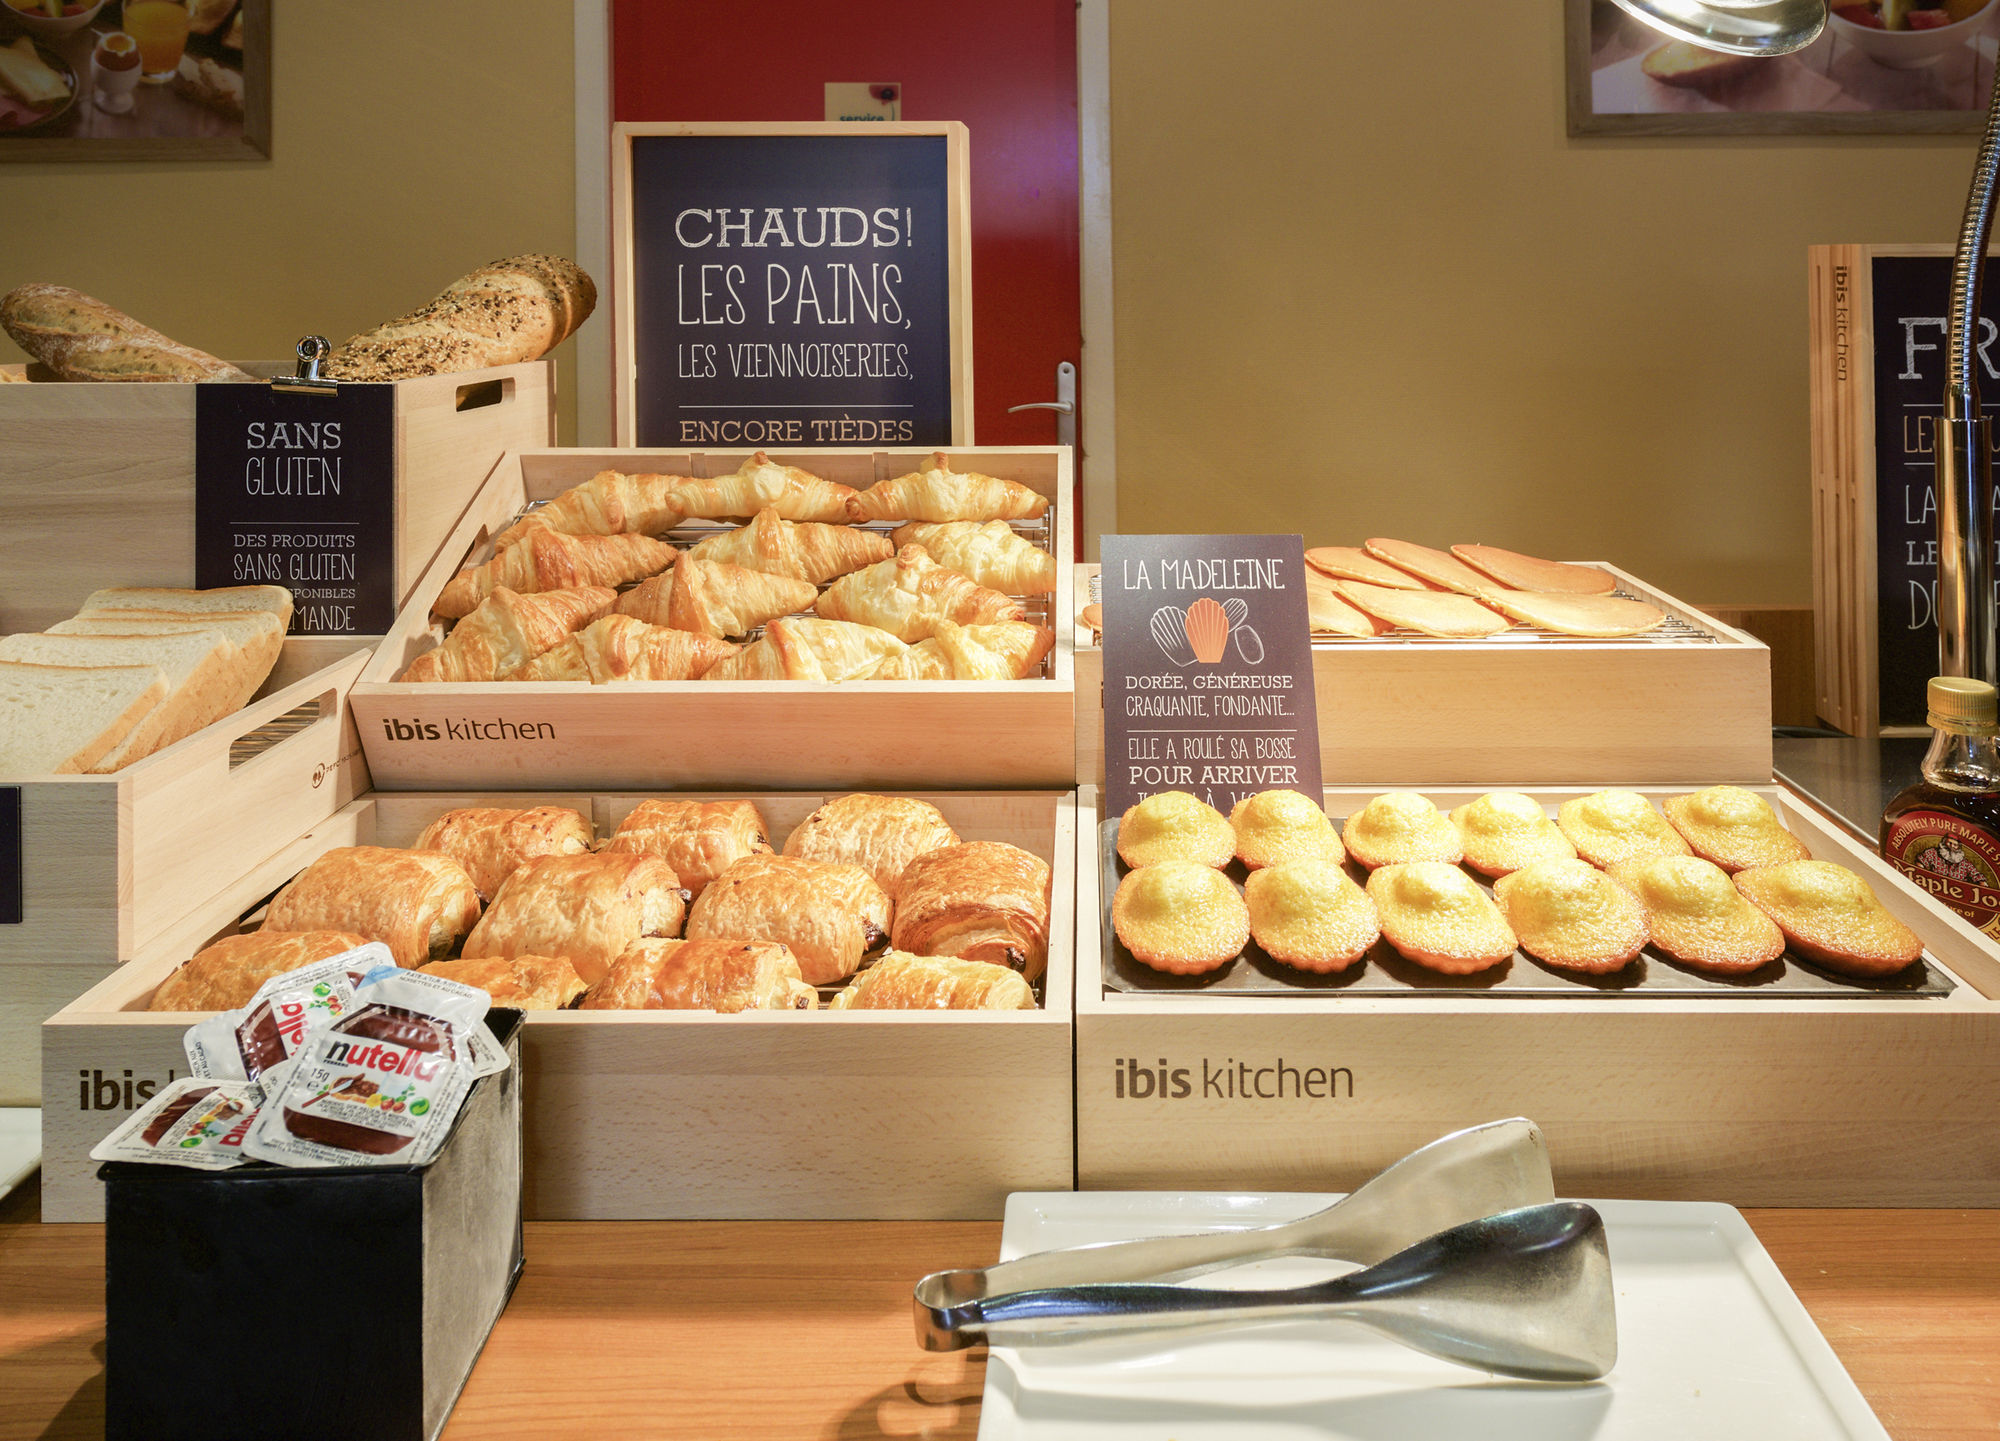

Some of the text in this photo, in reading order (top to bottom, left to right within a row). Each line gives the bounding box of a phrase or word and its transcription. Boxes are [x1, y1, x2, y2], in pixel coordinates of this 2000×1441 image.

[675, 207, 912, 248] CHAUDS!
[679, 263, 911, 330] LES PAINS,
[1836, 266, 1848, 381] ibis kitchen
[679, 343, 914, 381] LES VIENNOISERIES,
[247, 422, 342, 450] SANS
[679, 413, 914, 442] ENCORE TIÈDES
[246, 457, 342, 496] GLUTEN
[233, 534, 356, 548] DES PRODUITS
[233, 553, 356, 581] SANS GLUTEN
[1123, 558, 1285, 590] LA MADELEINE
[289, 588, 356, 599] PONIBLES
[288, 605, 356, 630] MANDE
[1125, 672, 1293, 690] DORÉE, GÉNÉREUSE
[1126, 696, 1209, 718] CRAQUANTE,
[382, 718, 556, 741] ibis kitchen
[1128, 735, 1297, 760] ELLE A ROULÉ SA BOSSE
[1129, 766, 1299, 785] POUR ARRIVER
[1892, 817, 1997, 855] ABSOLUTELY PURE MAPLE
[1894, 860, 2000, 908] Maple Jo
[311, 1067, 330, 1082] 15g
[325, 1041, 439, 1083] nutella
[80, 1069, 155, 1110] ibis
[1115, 1058, 1354, 1099] ibis kitchen
